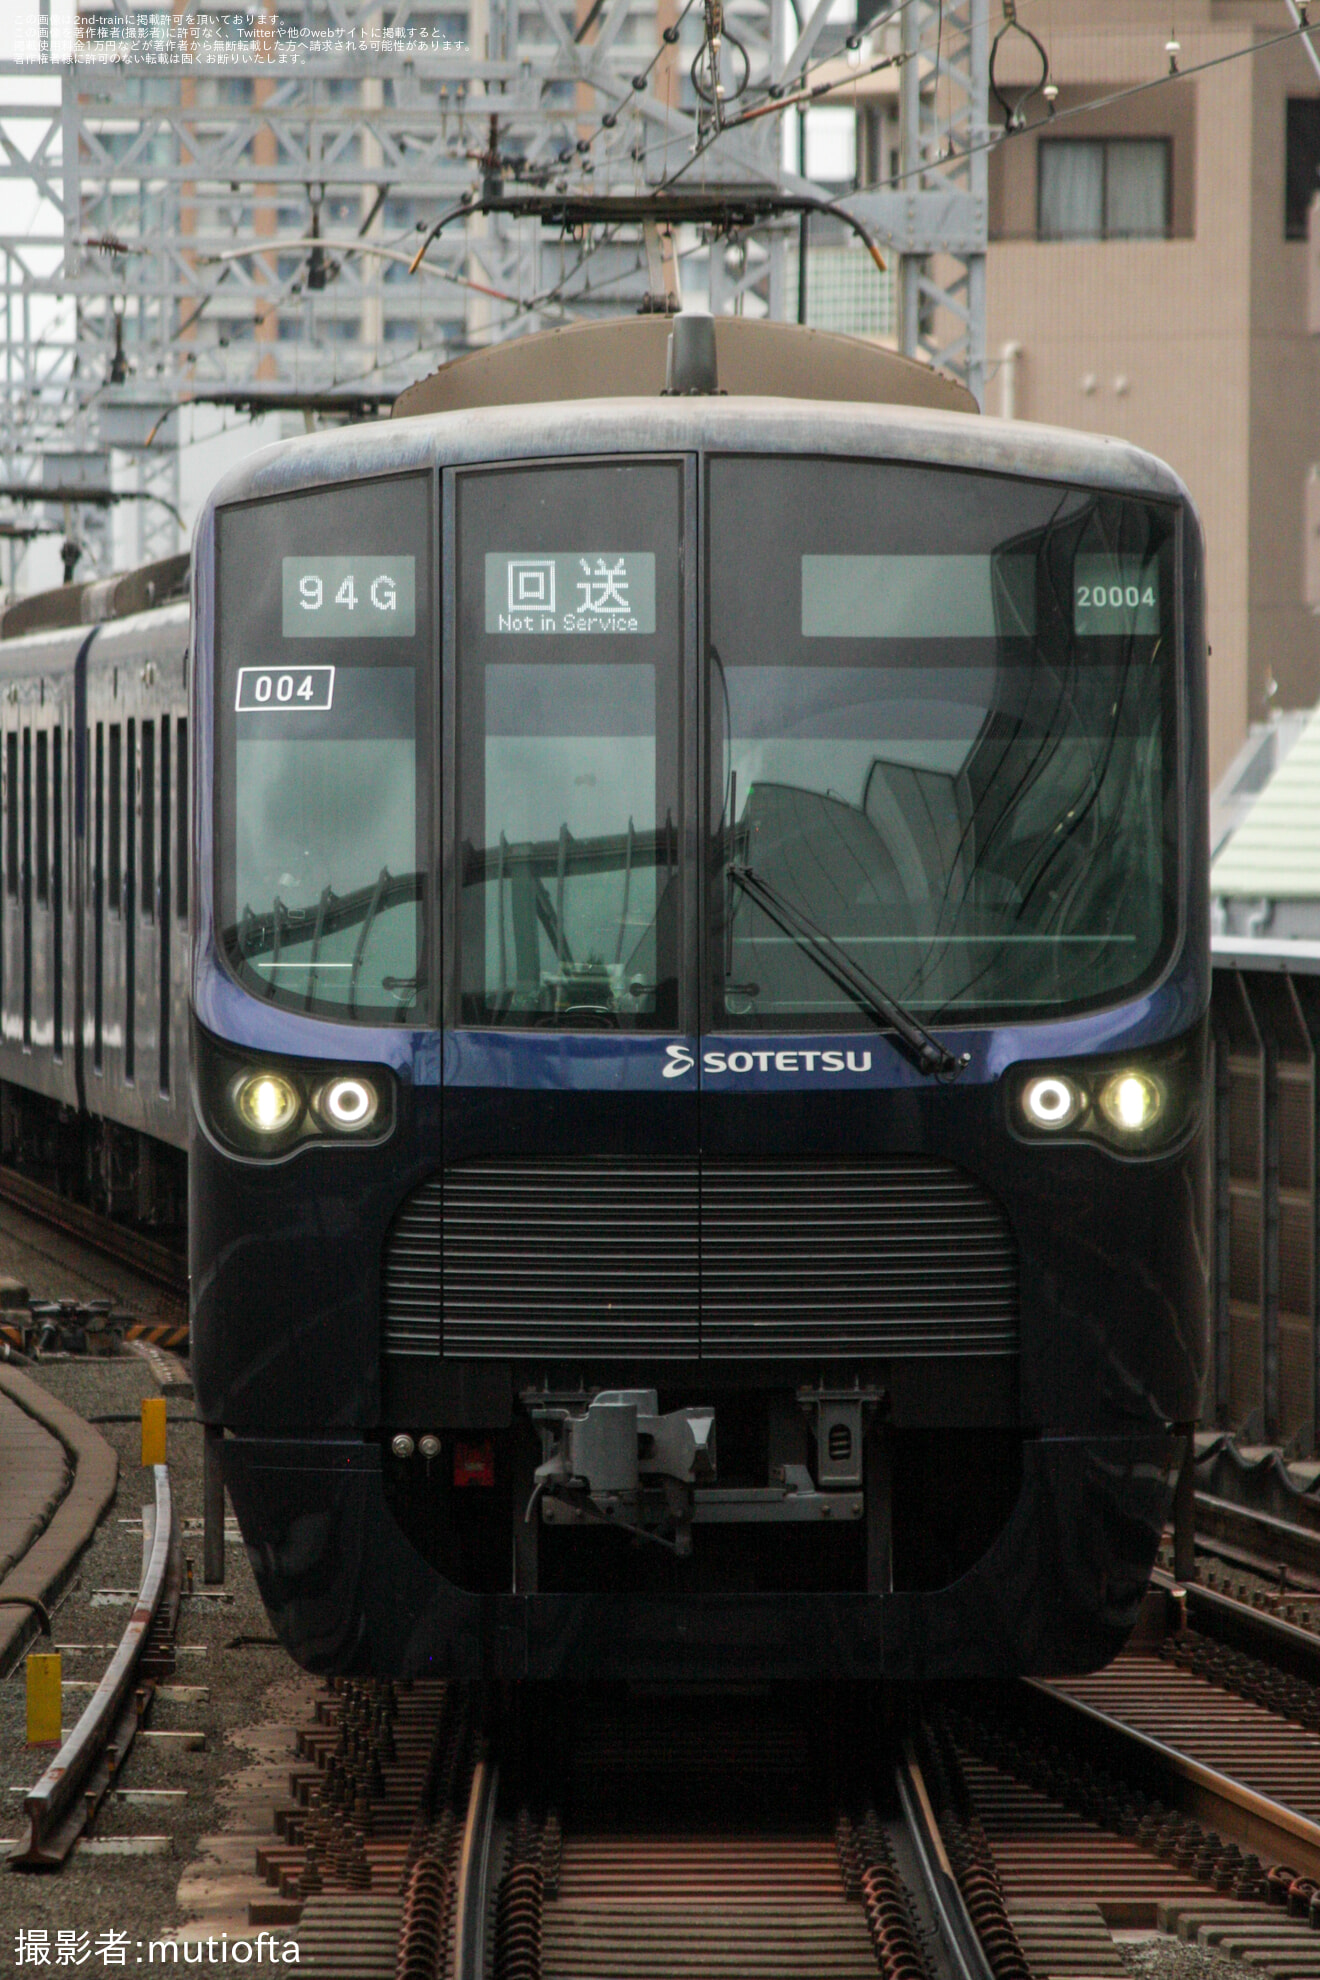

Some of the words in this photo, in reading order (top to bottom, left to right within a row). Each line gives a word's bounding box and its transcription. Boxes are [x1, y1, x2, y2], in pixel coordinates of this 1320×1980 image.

[299, 574, 397, 610] 94G
[508, 557, 632, 613] 回送
[1077, 586, 1156, 607] 20004
[498, 613, 534, 631] Not
[541, 613, 556, 631] in
[563, 613, 638, 631] Service
[254, 675, 314, 702] 004
[703, 1051, 872, 1073] SOTETSU
